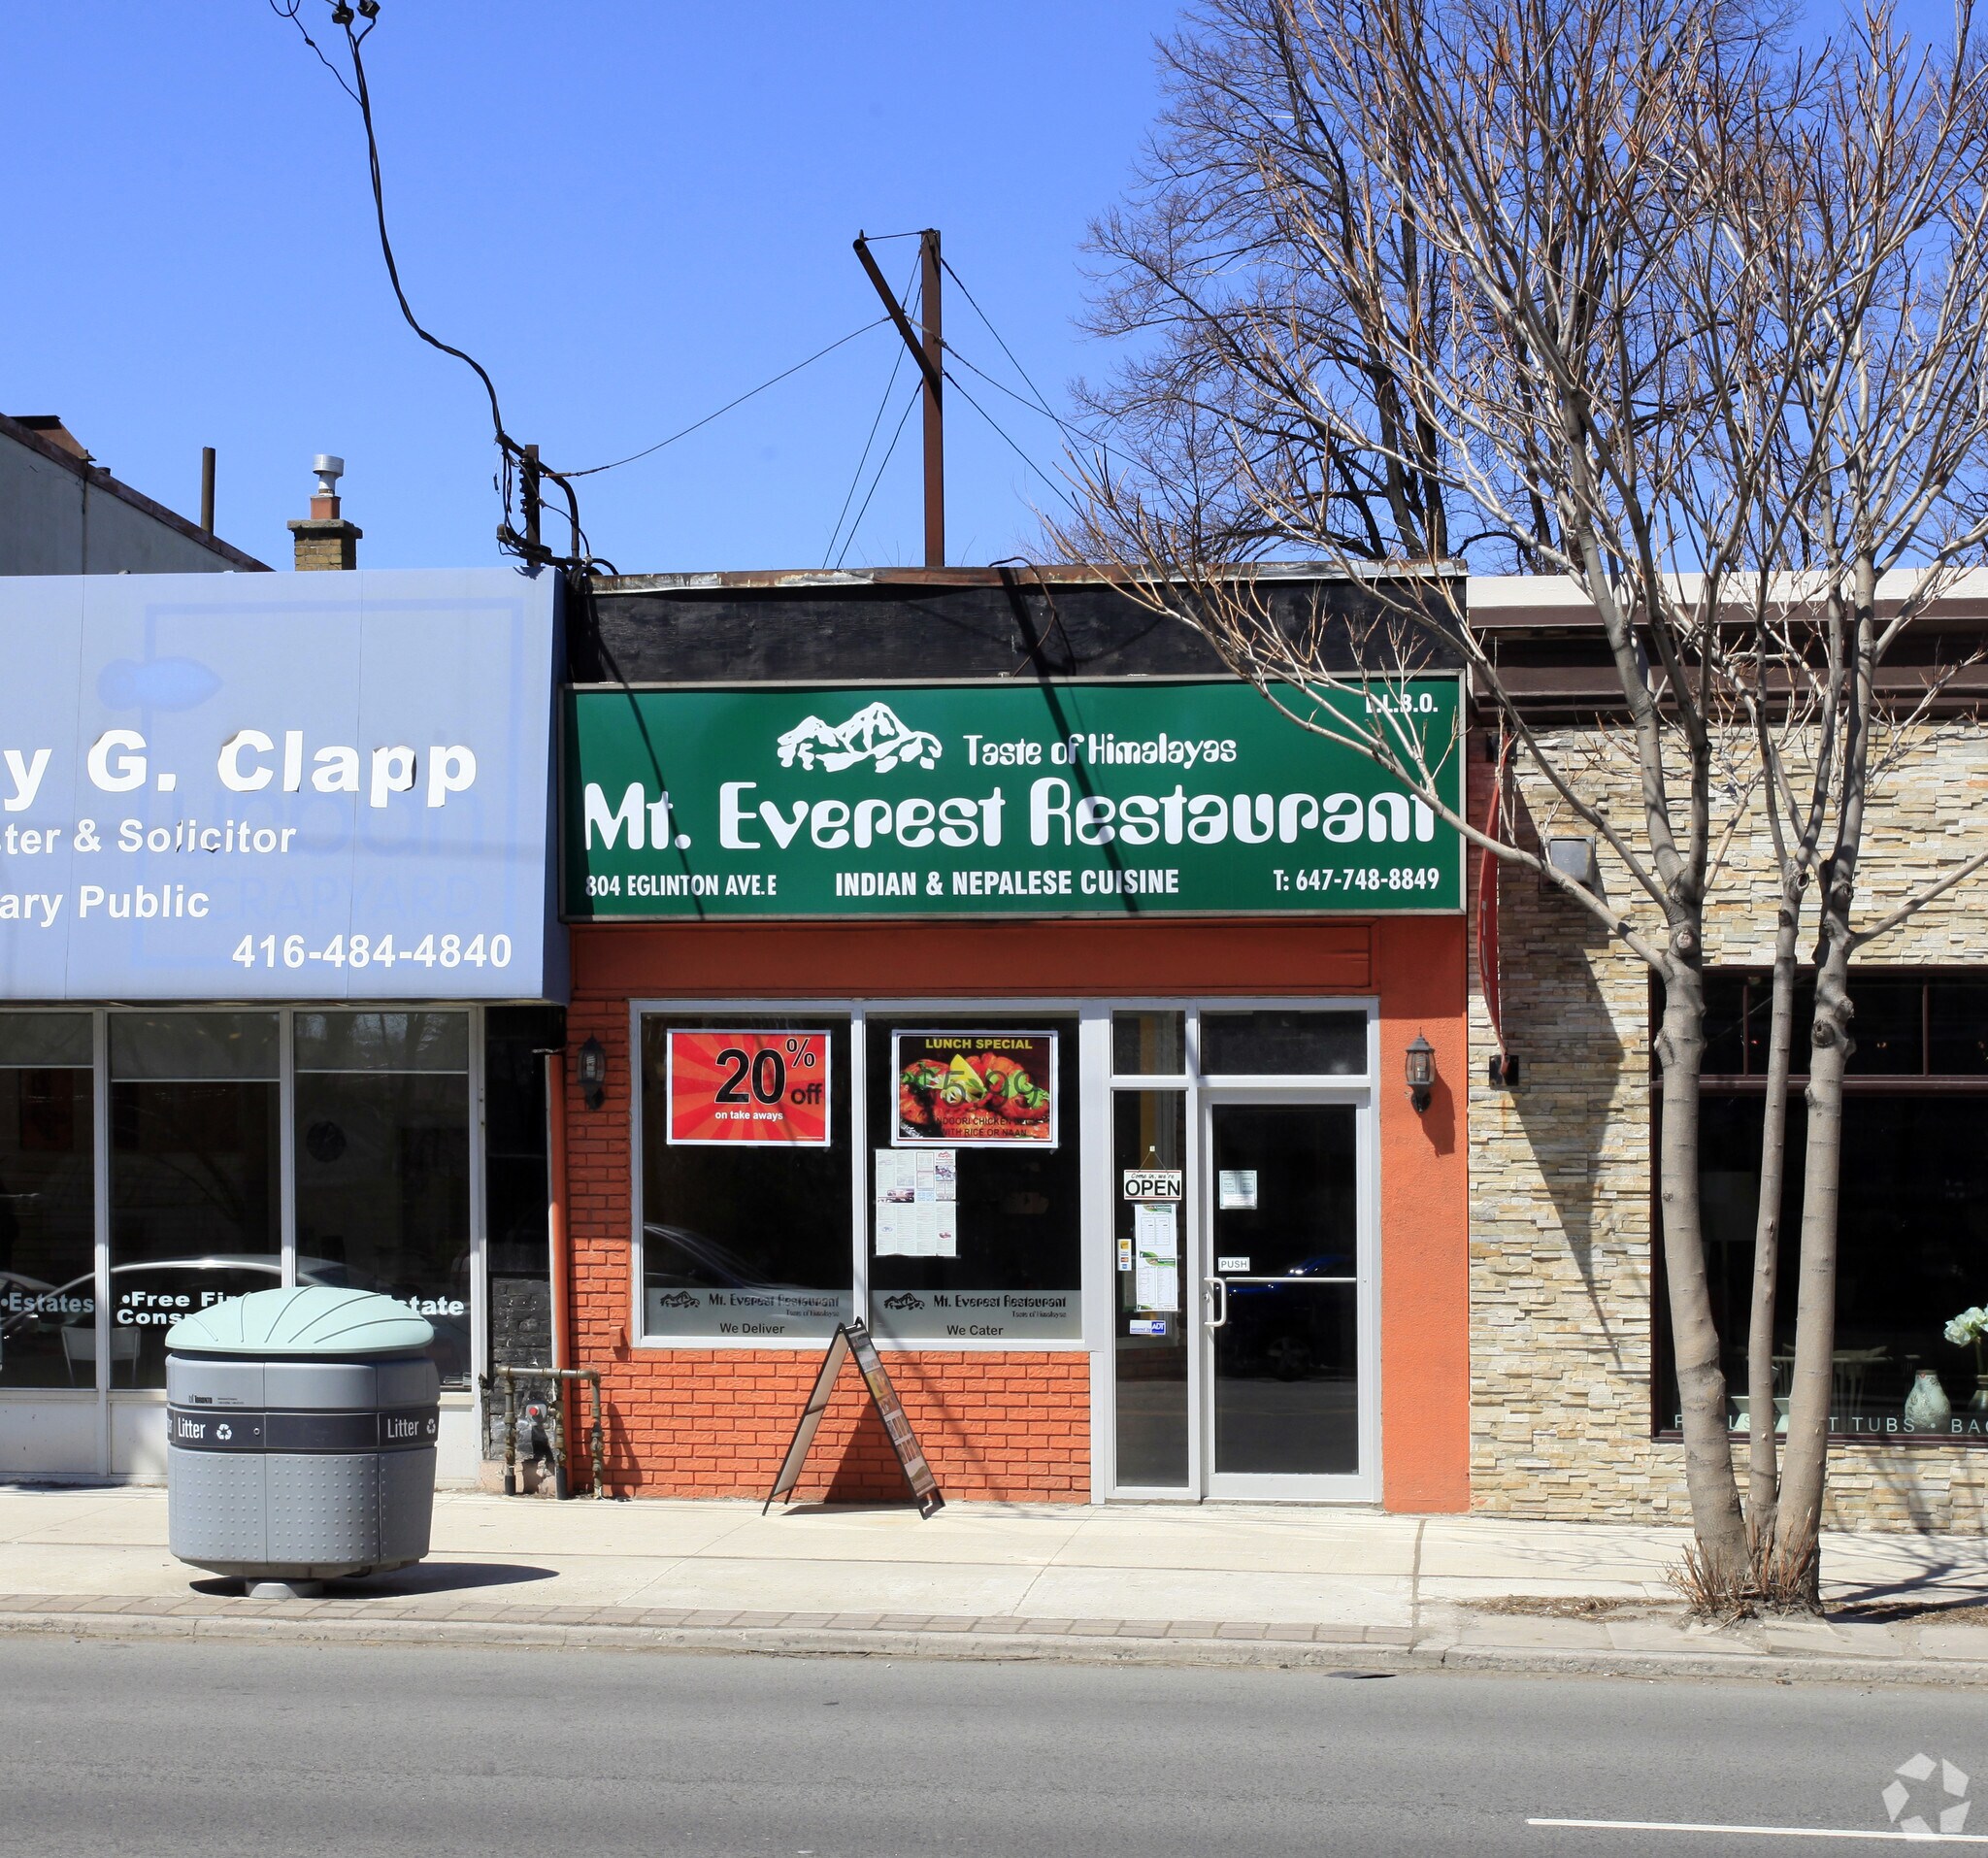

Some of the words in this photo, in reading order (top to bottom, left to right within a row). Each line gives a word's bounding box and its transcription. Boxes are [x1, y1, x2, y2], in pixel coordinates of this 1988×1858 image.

[963, 735, 1042, 766] Taste
[1051, 734, 1084, 764] of
[1089, 733, 1237, 770] Himalayas
[87, 729, 176, 792] G.
[217, 729, 477, 809] Clapp
[584, 782, 691, 850] Mt.
[719, 782, 1006, 849] Everest
[1030, 778, 1434, 846] Restaurant
[74, 818, 101, 852] &
[117, 818, 297, 852] Solicitor
[586, 875, 621, 897] 804
[627, 875, 719, 897] EGLINTON
[835, 872, 917, 896] INDIAN
[925, 871, 944, 896] &
[952, 870, 1073, 896] NEPALESE
[1080, 869, 1179, 895] CUISINE
[1274, 870, 1289, 891] T:
[1295, 868, 1440, 891] 647-748-8849
[80, 883, 210, 918] Public
[233, 933, 513, 969] 416-484-4840
[925, 1039, 972, 1049] LUNCH
[975, 1039, 1033, 1049] SPECIAL
[790, 1082, 823, 1105] off
[730, 1111, 750, 1120] take
[752, 1111, 784, 1122] aways
[1003, 1127, 1027, 1136] NAAN
[1125, 1179, 1180, 1196] OPEN
[1220, 1260, 1247, 1269] PUSH
[933, 1294, 951, 1308] Mt.
[955, 1294, 1000, 1308] Everest
[1004, 1294, 1067, 1308] Restaurant
[720, 1323, 739, 1333] We
[743, 1323, 785, 1334] Deliver
[946, 1325, 966, 1336] We
[969, 1325, 1004, 1336] Cater
[178, 1417, 207, 1439] Litter
[387, 1418, 419, 1439] Litter
[1851, 1416, 1915, 1433] TUBS
